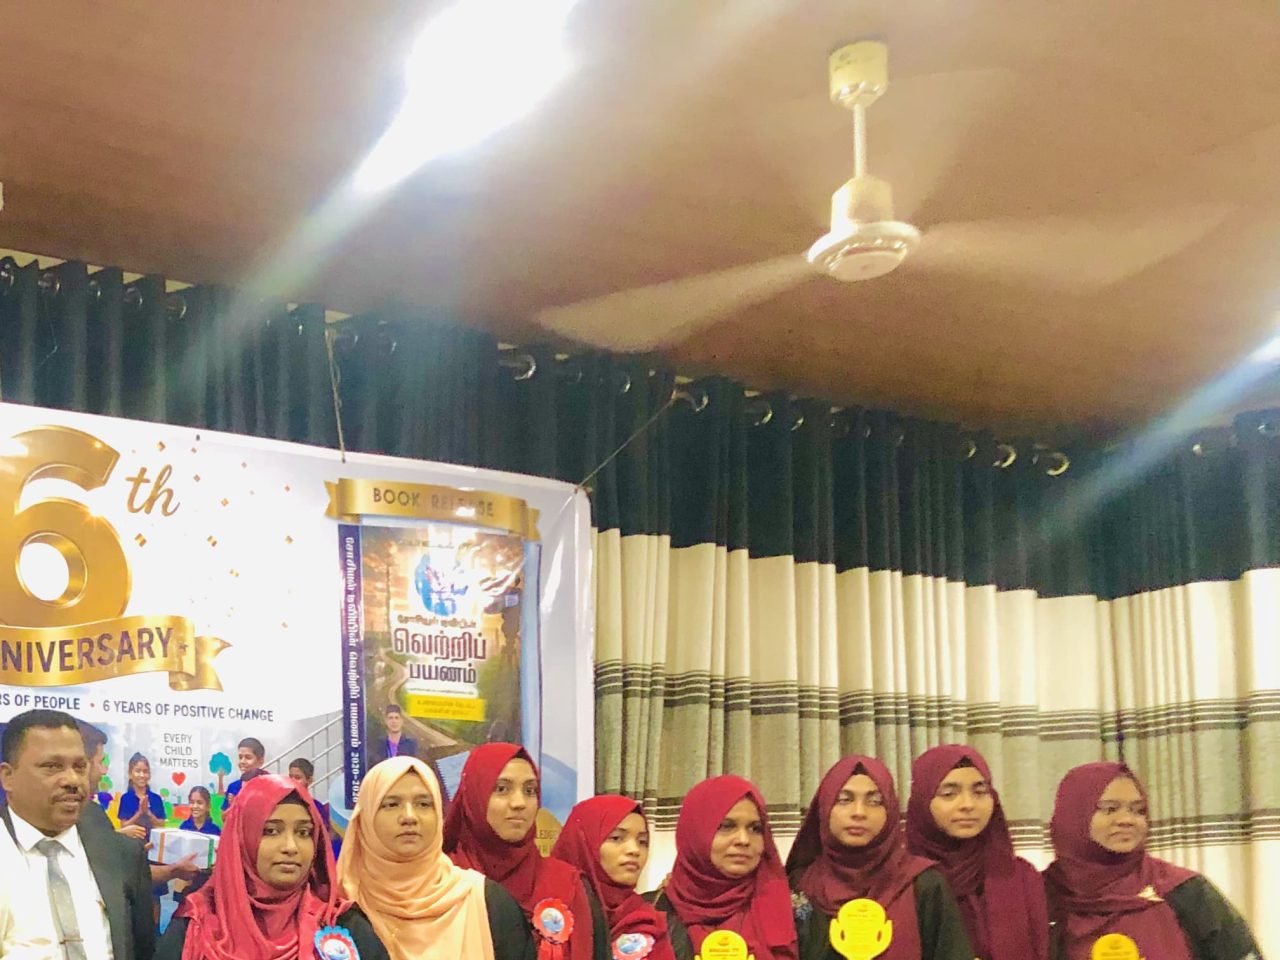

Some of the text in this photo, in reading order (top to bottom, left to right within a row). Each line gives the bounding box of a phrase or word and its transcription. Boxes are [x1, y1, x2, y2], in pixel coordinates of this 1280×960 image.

[125, 464, 181, 516] th
[373, 487, 420, 507] BOOK
[394, 628, 486, 663] வெற்றிப்
[409, 663, 477, 684] பயணம்
[14, 694, 31, 707] OF
[34, 695, 81, 710] PEOPLE
[102, 699, 274, 722] 6 YEARS OF POSITIVE CHANGE
[163, 732, 193, 744] EVERY
[164, 745, 193, 756] CHILD
[159, 757, 200, 769] MATTERS
